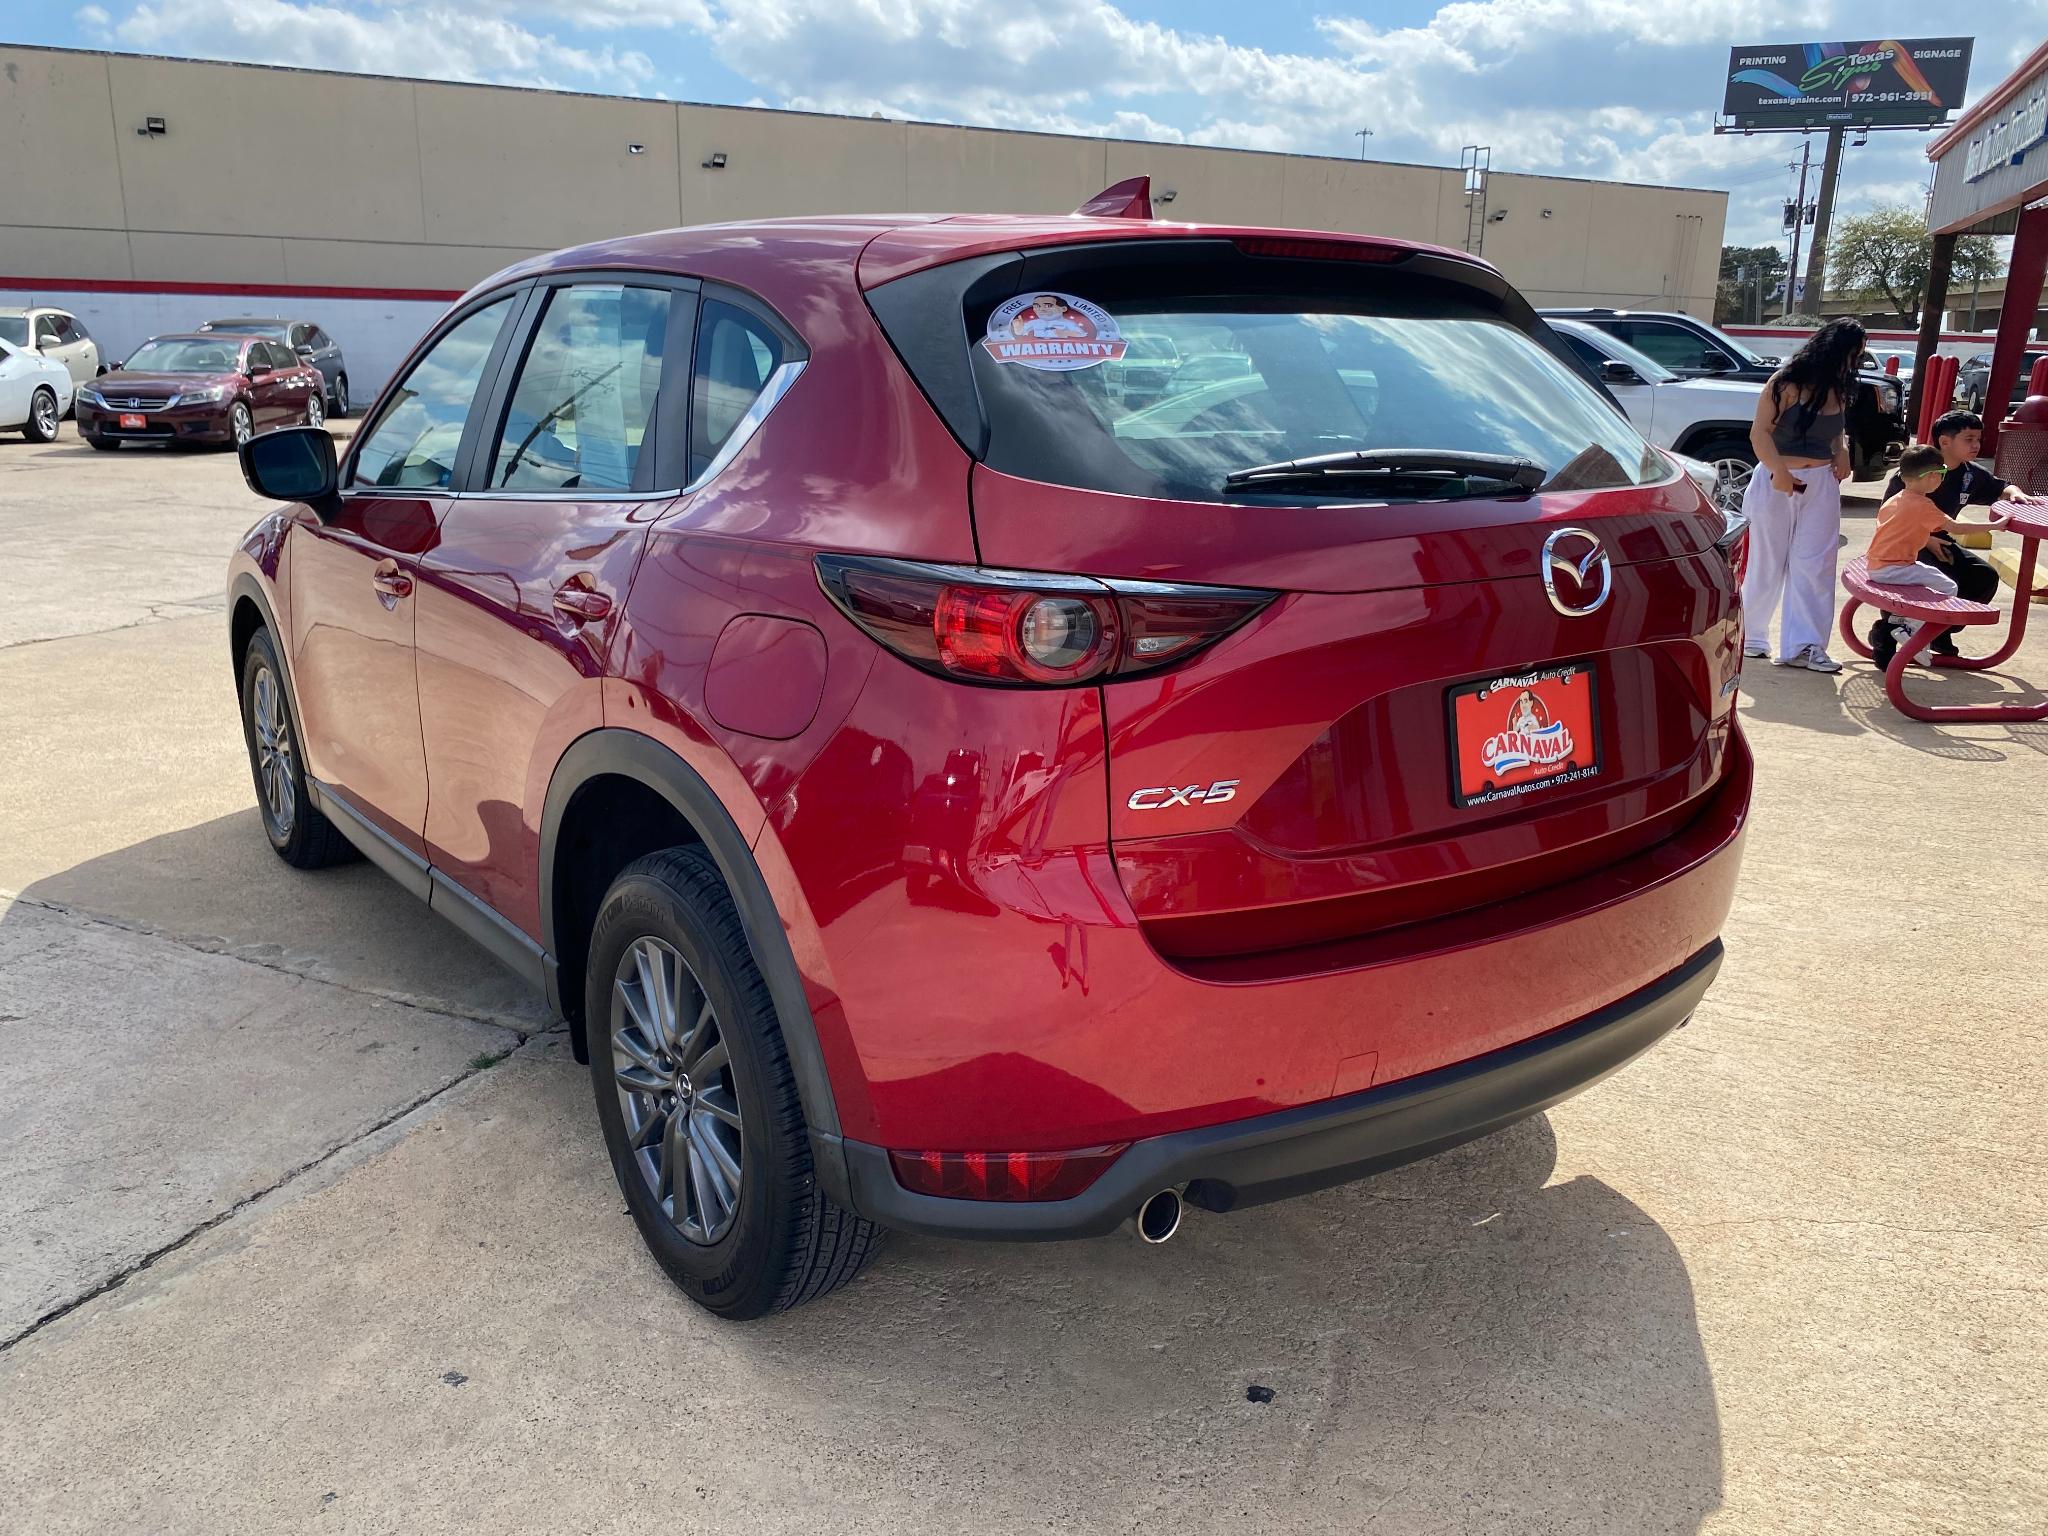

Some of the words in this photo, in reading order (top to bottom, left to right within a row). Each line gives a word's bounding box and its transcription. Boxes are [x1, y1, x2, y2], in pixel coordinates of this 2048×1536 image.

[1739, 56, 1787, 66] PRINTING
[1849, 50, 1894, 67] Texas
[1913, 49, 1962, 59] SIGNAGE
[1758, 95, 1842, 106] texassignsinc.com
[1002, 300, 1026, 316] FREE
[1073, 301, 1108, 323] LIMITED
[999, 342, 1114, 358] WARRANTY
[1489, 672, 1539, 693] CARNAVAL
[1540, 671, 1556, 681] Auto
[1556, 666, 1577, 679] Credit
[1482, 728, 1572, 762] CARNAVAL
[1533, 766, 1548, 776] Auto
[1127, 779, 1241, 810] CX-5
[1467, 779, 1551, 807] www.CarnavalAutos.com
[1555, 766, 1598, 785] 972-241-8141
